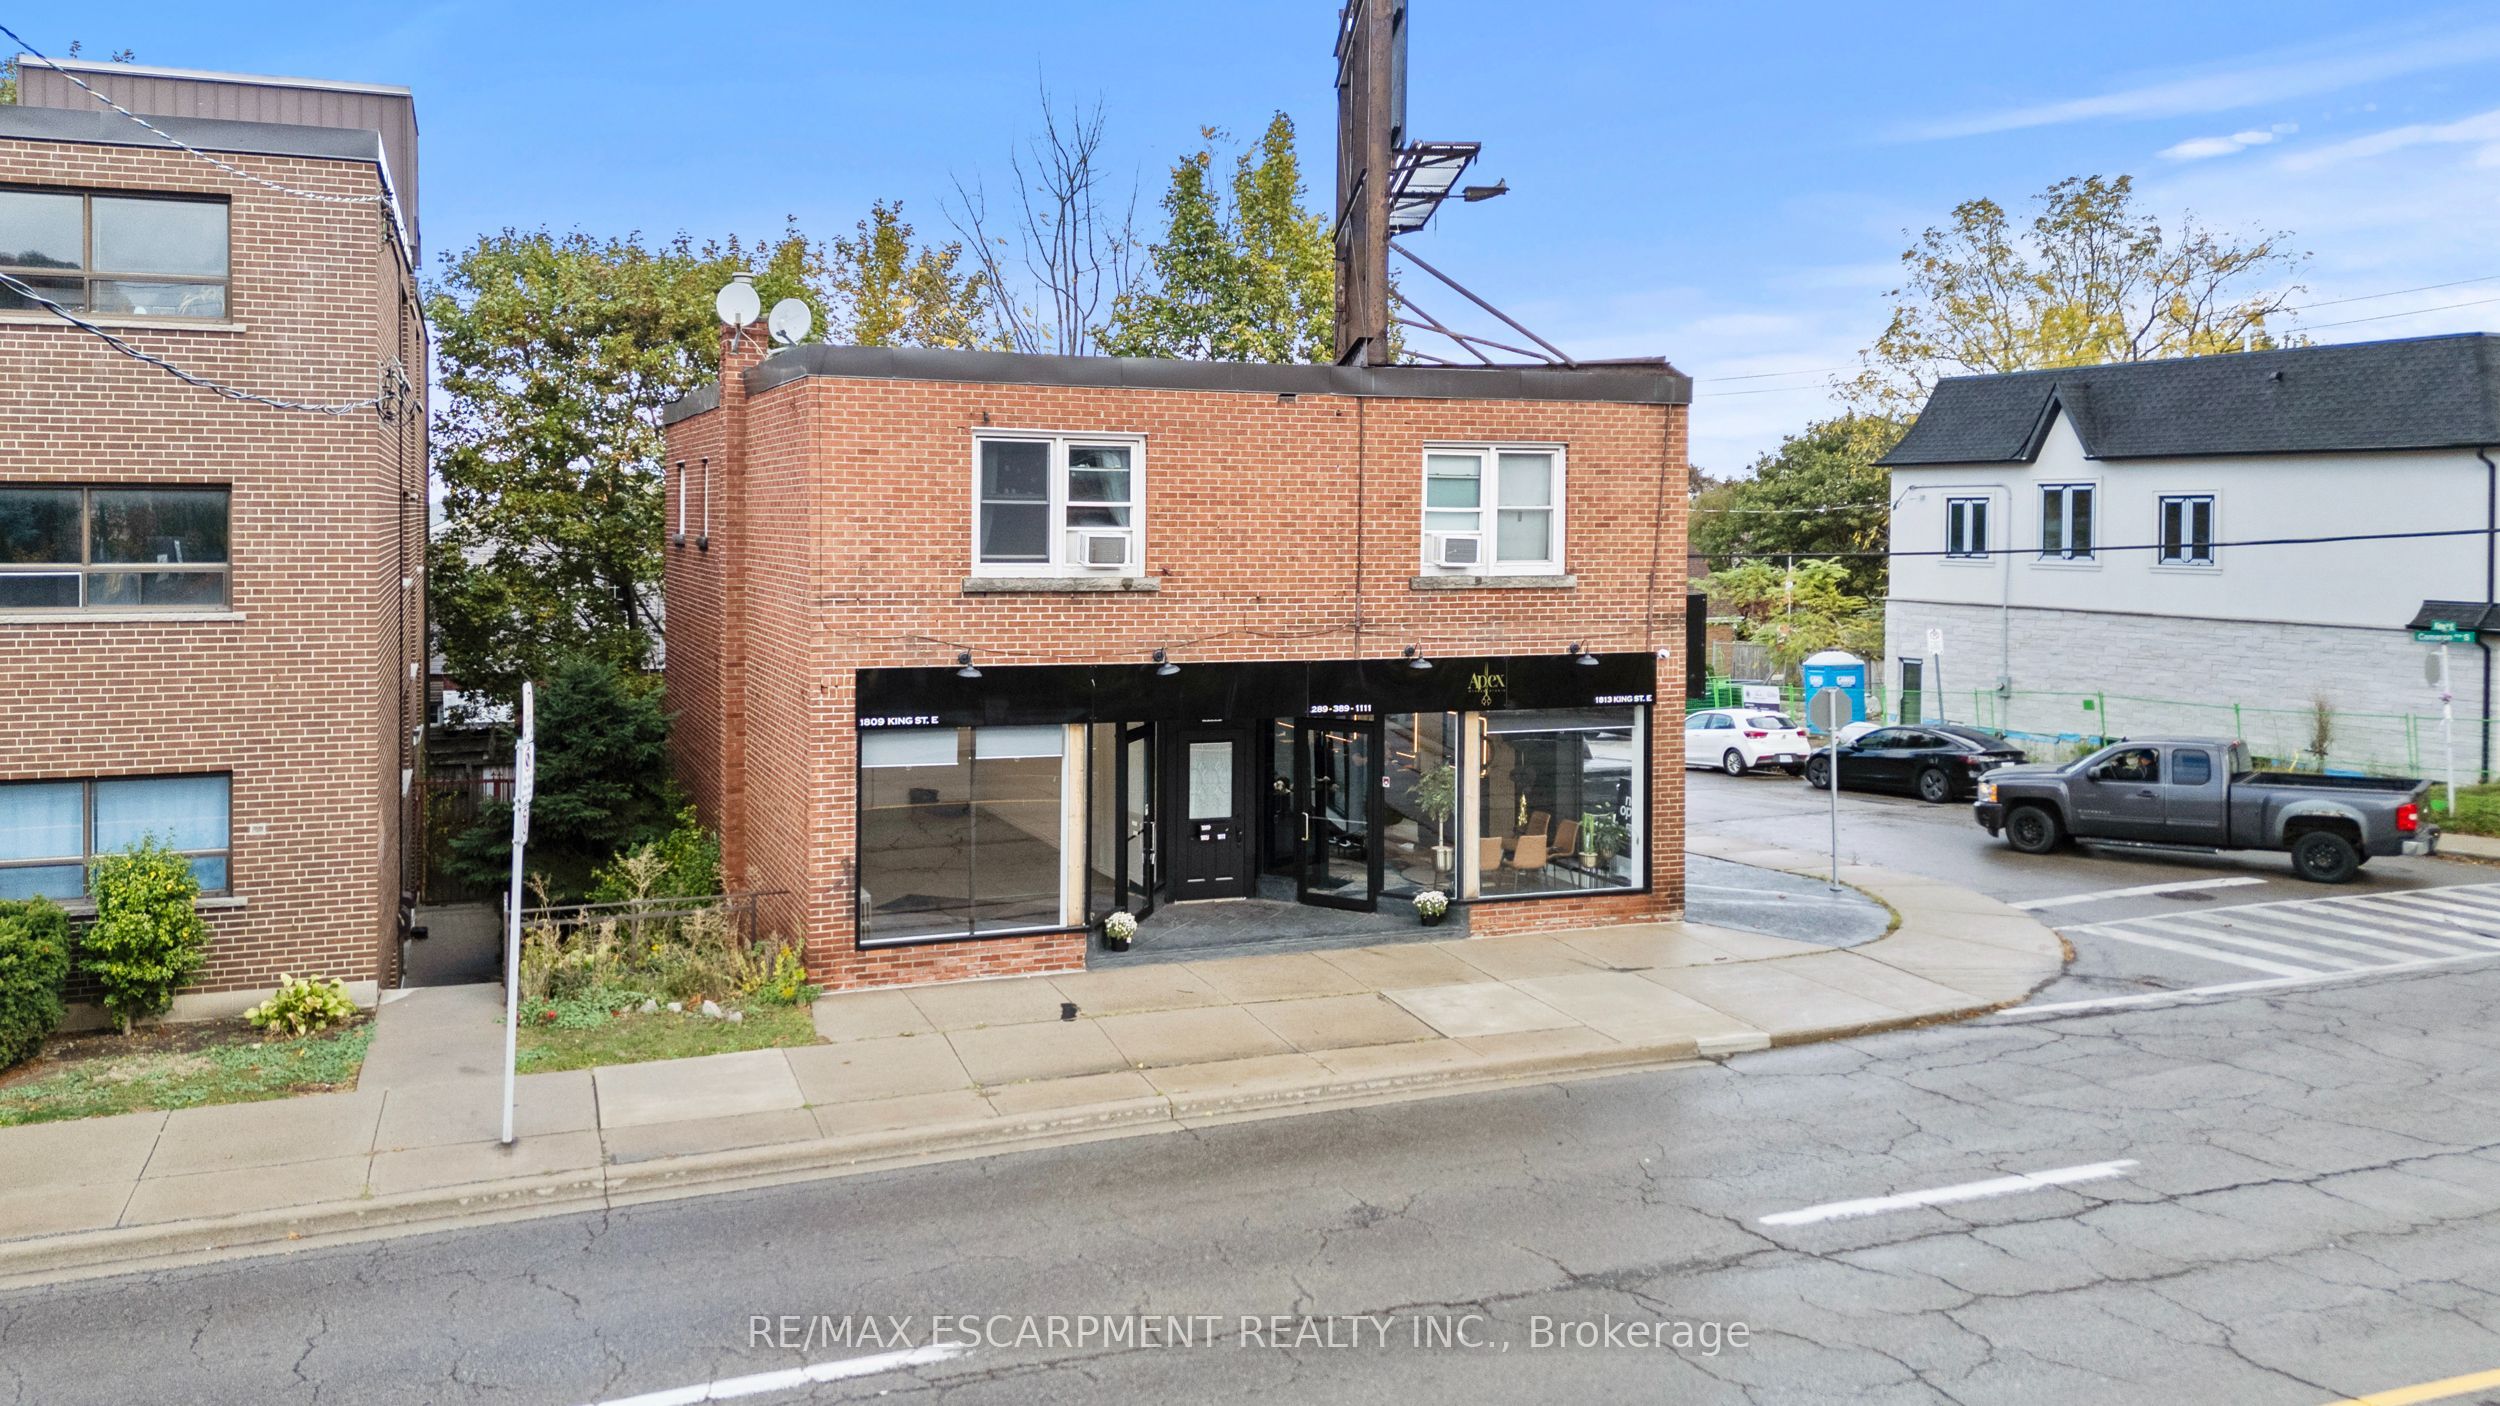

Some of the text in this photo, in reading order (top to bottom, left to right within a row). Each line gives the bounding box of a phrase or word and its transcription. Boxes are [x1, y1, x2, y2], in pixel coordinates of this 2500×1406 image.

[2418, 632, 2453, 641] Cameron
[1467, 672, 1506, 691] Apex
[1613, 694, 1633, 703] KING
[1633, 694, 1646, 702] ST.
[1646, 694, 1653, 702] E
[860, 715, 939, 727] 1809 KING ST. E
